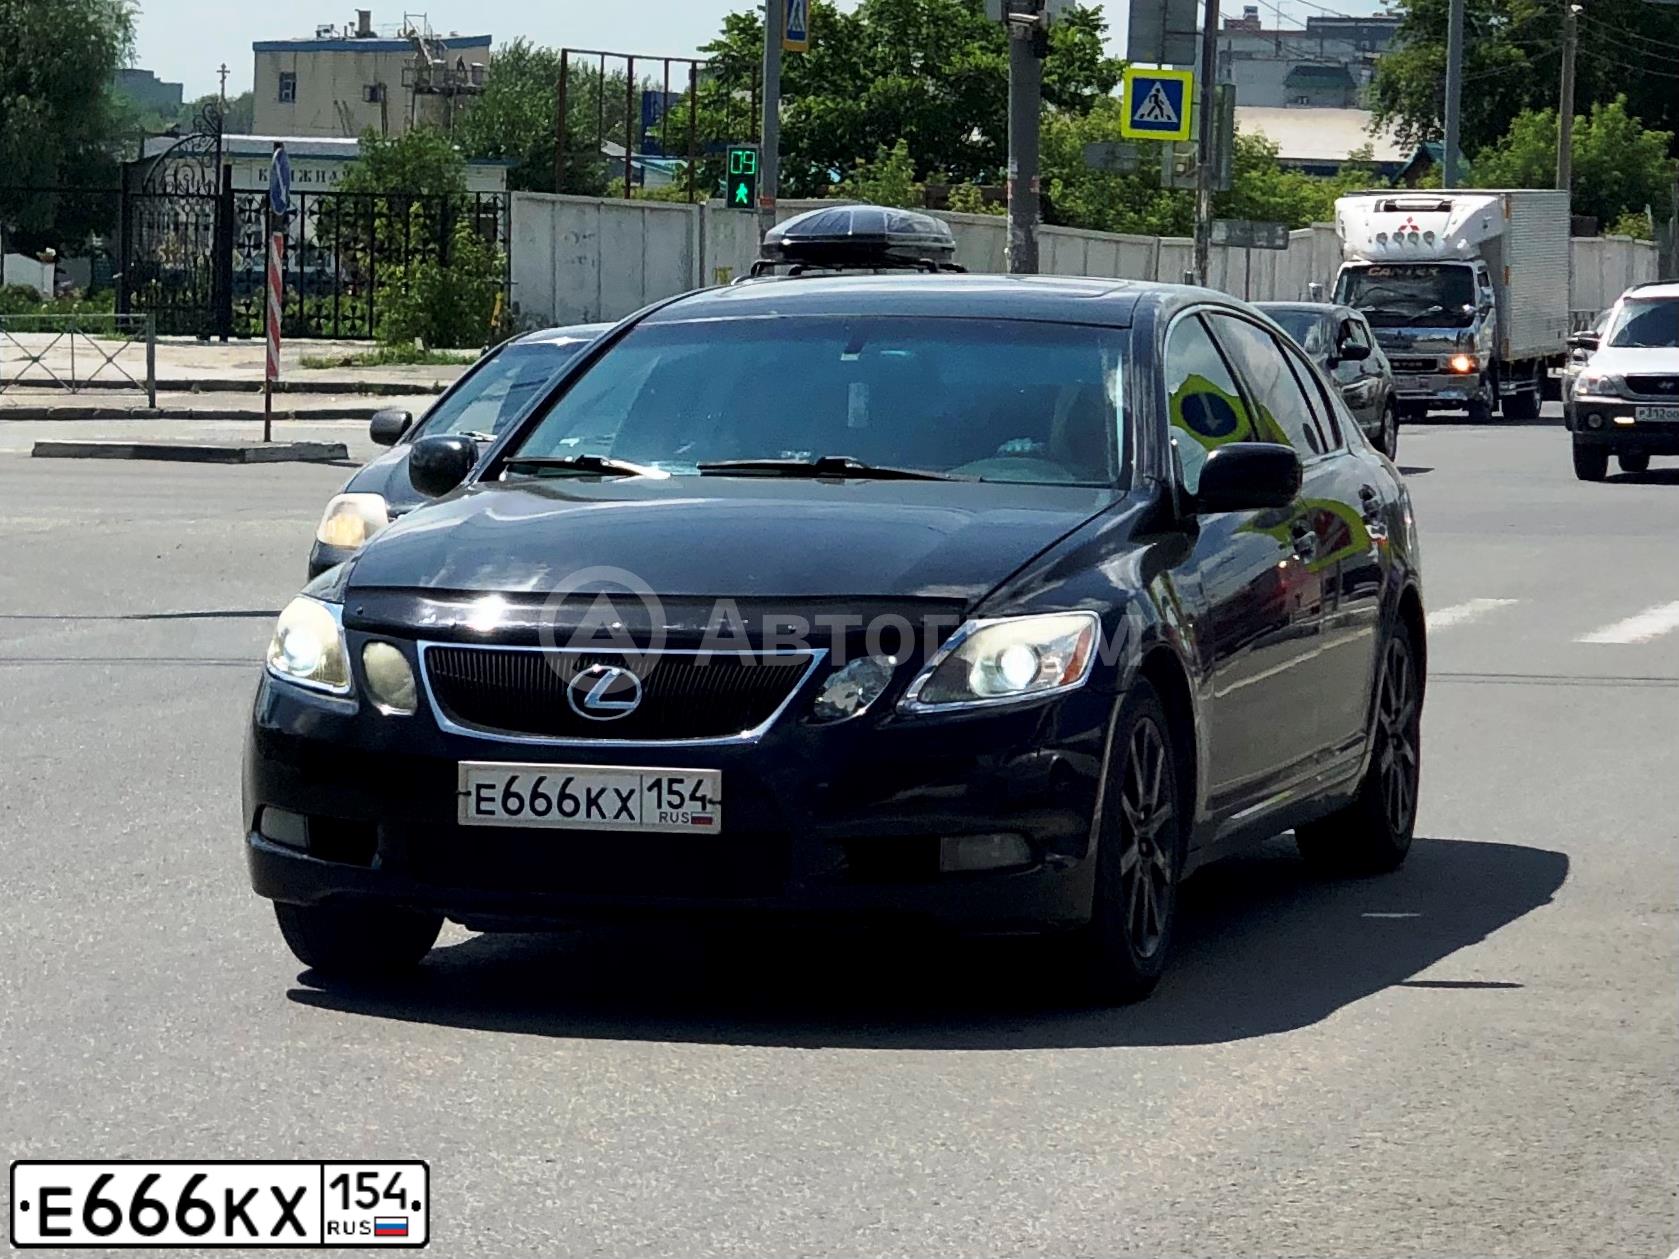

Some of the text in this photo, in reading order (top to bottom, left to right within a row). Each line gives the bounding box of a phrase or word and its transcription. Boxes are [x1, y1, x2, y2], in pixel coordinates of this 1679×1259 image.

[731, 151, 755, 174] 09
[258, 168, 351, 183] КЖНА
[646, 777, 707, 811] 154
[659, 811, 690, 824] RUS
